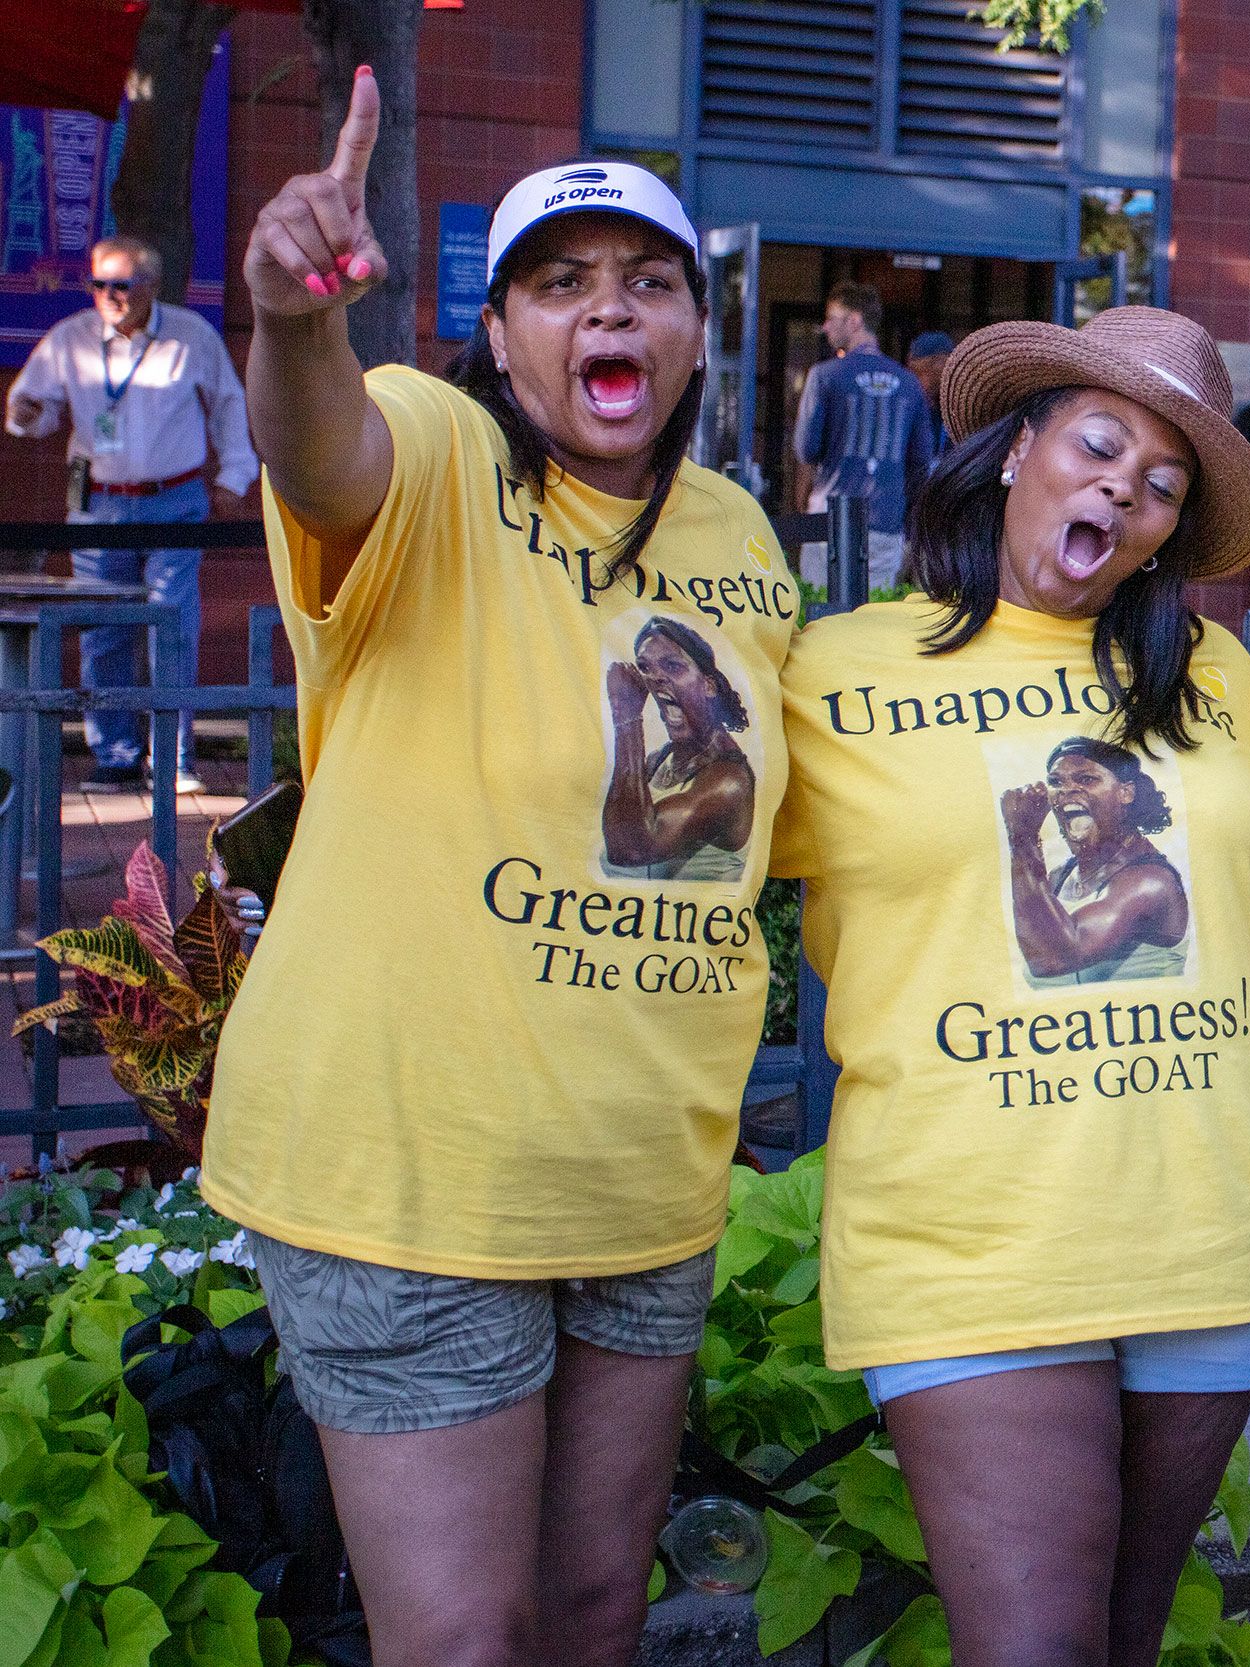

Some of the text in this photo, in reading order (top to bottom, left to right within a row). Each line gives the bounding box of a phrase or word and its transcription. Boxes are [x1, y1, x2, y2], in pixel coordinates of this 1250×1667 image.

[51, 110, 98, 251] US OPEN
[544, 187, 624, 209] us open
[532, 942, 744, 994] The GOAT
[935, 977, 1249, 1063] Greatness!
[989, 1052, 1219, 1109] The GOAT
